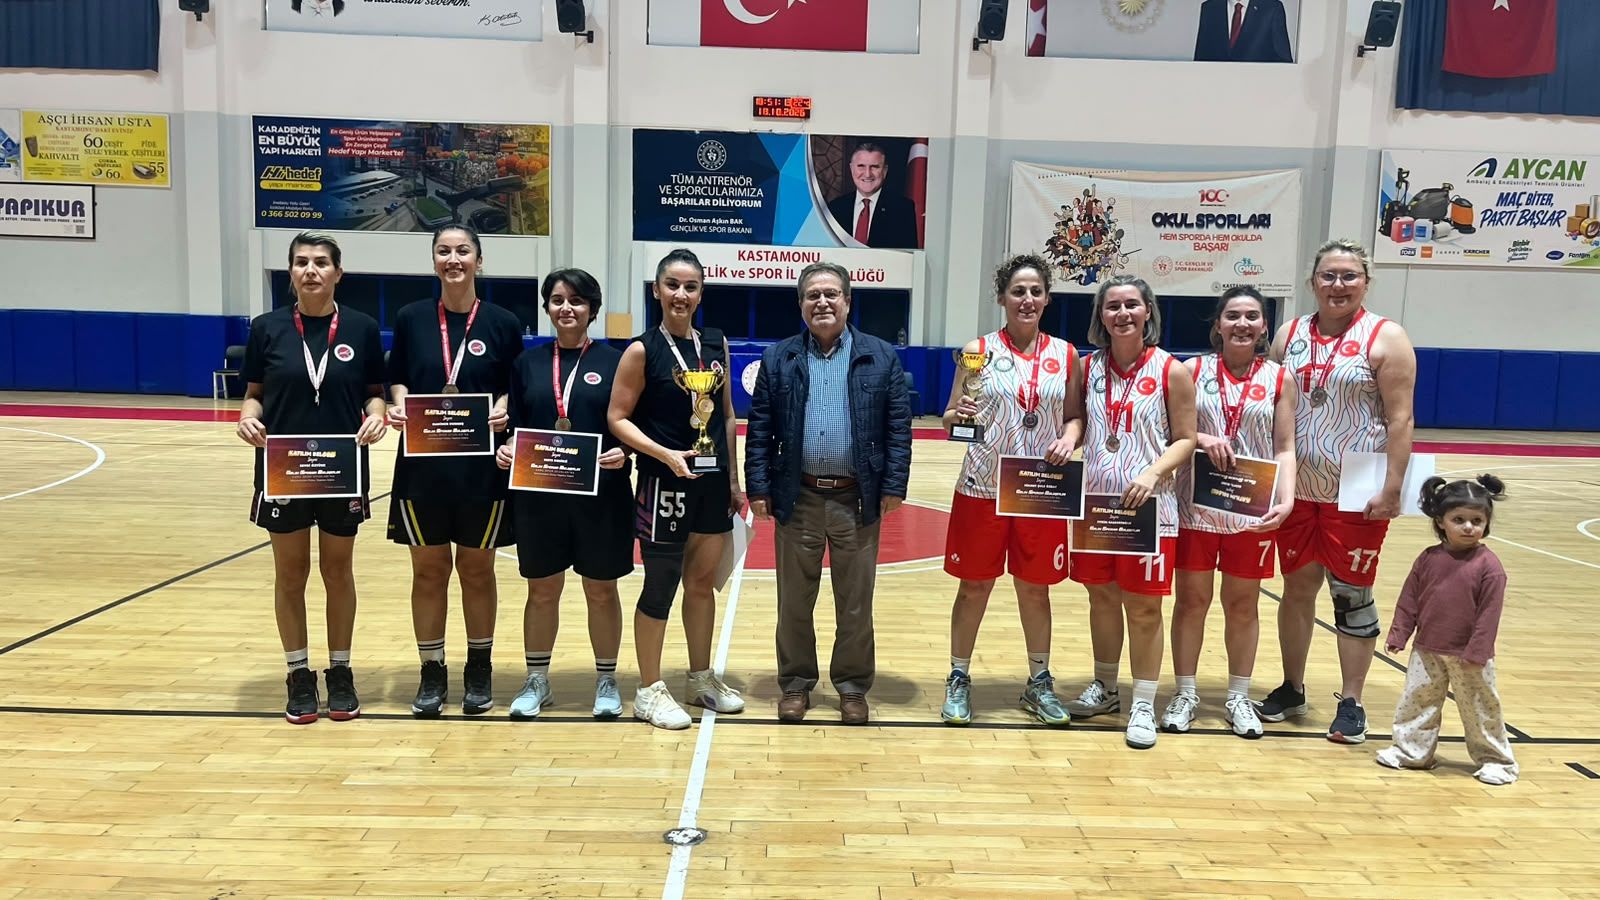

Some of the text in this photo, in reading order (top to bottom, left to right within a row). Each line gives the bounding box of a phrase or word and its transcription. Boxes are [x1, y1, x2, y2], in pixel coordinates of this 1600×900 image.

[38, 113, 152, 128] AŞÇI İHSAN USTA
[258, 125, 321, 135] KARADENİZ'İN
[83, 133, 103, 149] 60
[258, 134, 321, 147] EN BÜYÜK
[38, 152, 80, 161] KAHVALTI
[260, 147, 321, 156] YAPI MARKETİ
[351, 148, 368, 157] Yapı
[149, 161, 165, 174] 55
[1501, 158, 1587, 182] AYCAN
[670, 173, 753, 187] TÜM ANTRENÖR
[658, 185, 764, 198] VE SPORCULARIMIZA
[661, 197, 762, 208] BAŞARILAR DİLİYORUM
[1495, 190, 1554, 208] MAÇ BİTER,
[268, 210, 283, 218] 366
[300, 211, 311, 219] 09
[312, 211, 323, 219] 99
[1151, 211, 1272, 230] OKUL SPORLARI
[1480, 208, 1567, 229] PARTİ BAŞLAR
[670, 225, 698, 233] GENÇLİK
[1159, 233, 1263, 242] HEM SPORDA HEM OKULDA
[1193, 242, 1230, 253] BAŞARI
[737, 249, 821, 264] KASTAMONU
[730, 269, 746, 279] ve
[748, 267, 783, 280] SPOR
[785, 266, 797, 280] İL
[659, 491, 686, 518] 55
[1053, 543, 1064, 571] 6
[1258, 540, 1272, 567] 7
[1347, 547, 1377, 574] 17
[1139, 553, 1165, 582] 11
